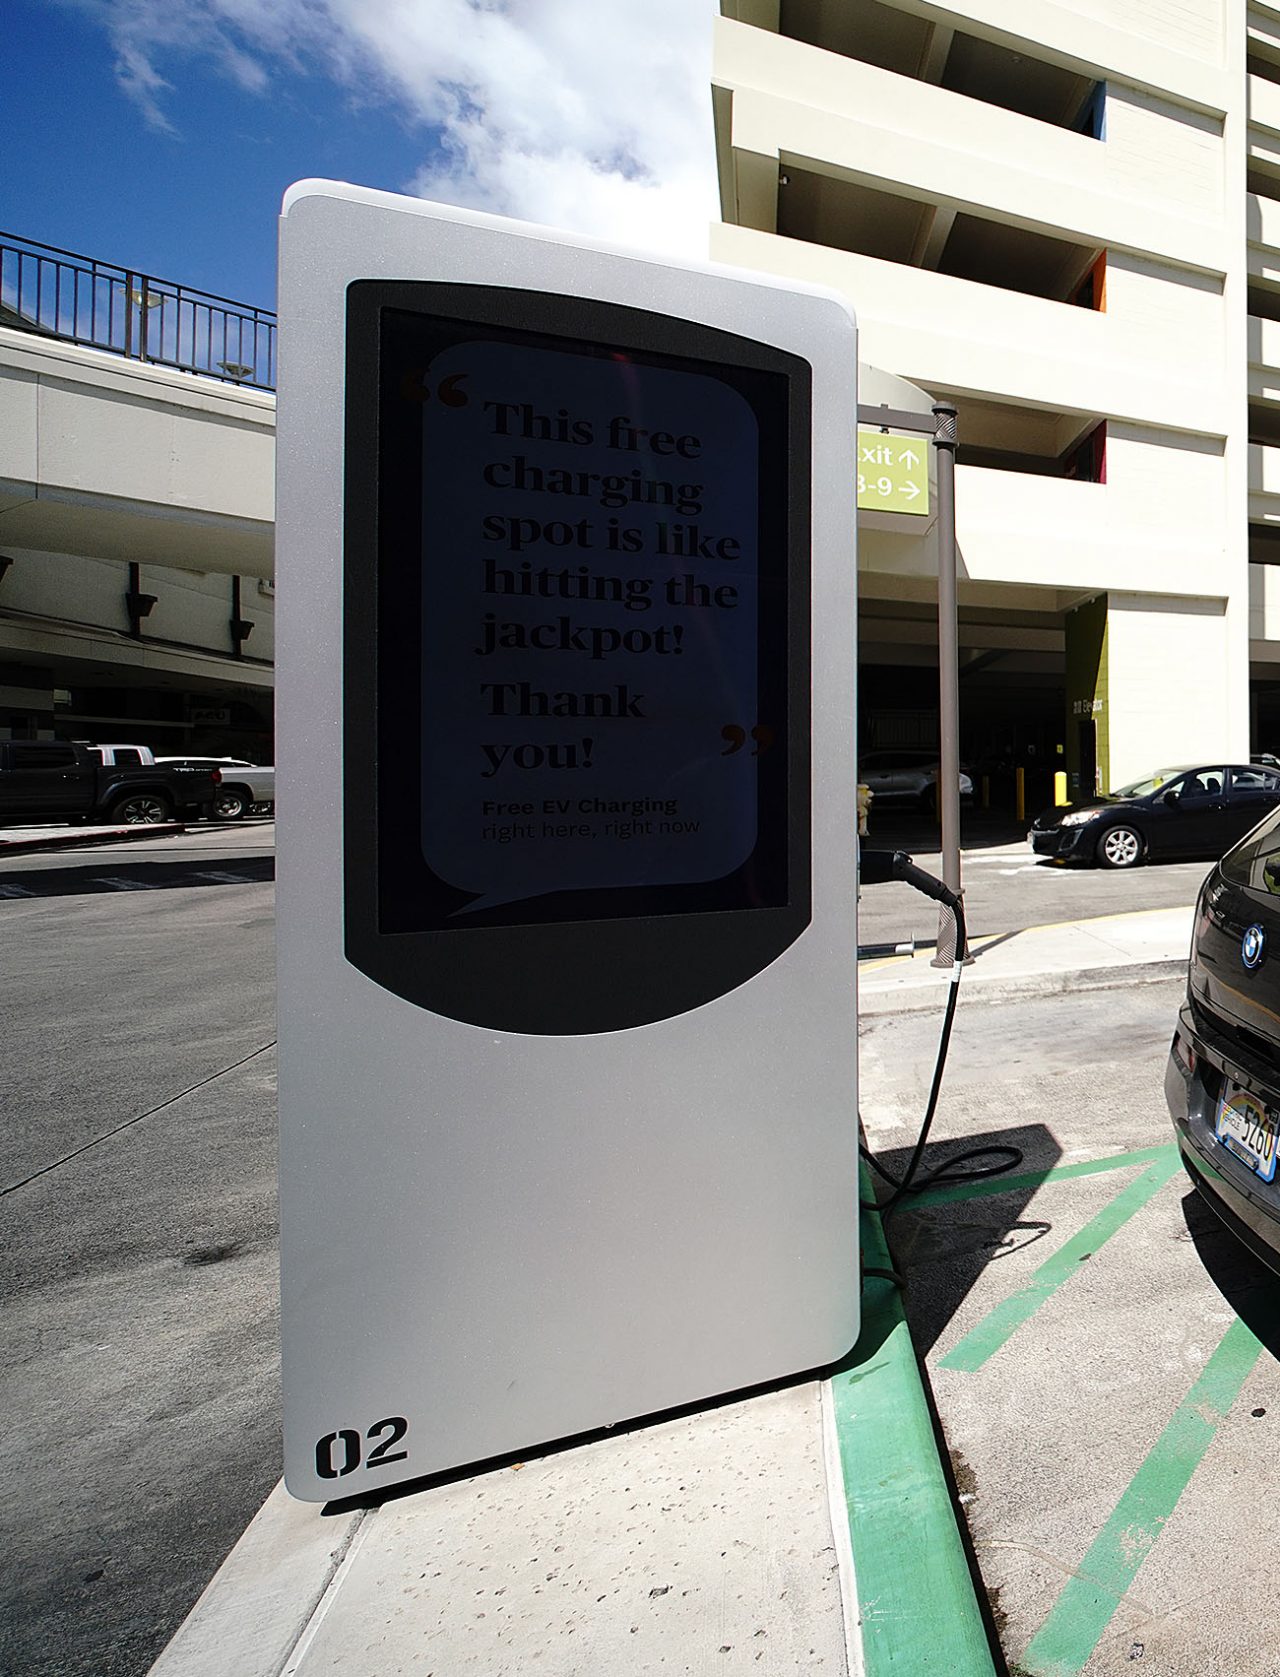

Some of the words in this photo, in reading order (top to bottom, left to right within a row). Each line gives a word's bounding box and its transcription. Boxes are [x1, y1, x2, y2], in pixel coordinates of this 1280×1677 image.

[483, 401, 595, 446] This
[608, 416, 702, 460] free
[858, 445, 893, 466] xit
[482, 455, 704, 517] charging
[482, 514, 594, 552] spot
[606, 518, 644, 554] is
[655, 521, 742, 561] like
[482, 558, 654, 613] hitting
[665, 574, 739, 610] the
[474, 612, 688, 662] jackpot!
[480, 681, 647, 719] Thank
[480, 737, 594, 780] you!
[482, 800, 534, 817] Free
[543, 799, 571, 815] EV
[578, 796, 678, 819] Charging
[482, 822, 535, 844] right
[542, 821, 598, 840] here,
[604, 820, 653, 840] right
[658, 820, 701, 835] now
[1241, 1104, 1275, 1162] 5260
[315, 1416, 408, 1479] 02
